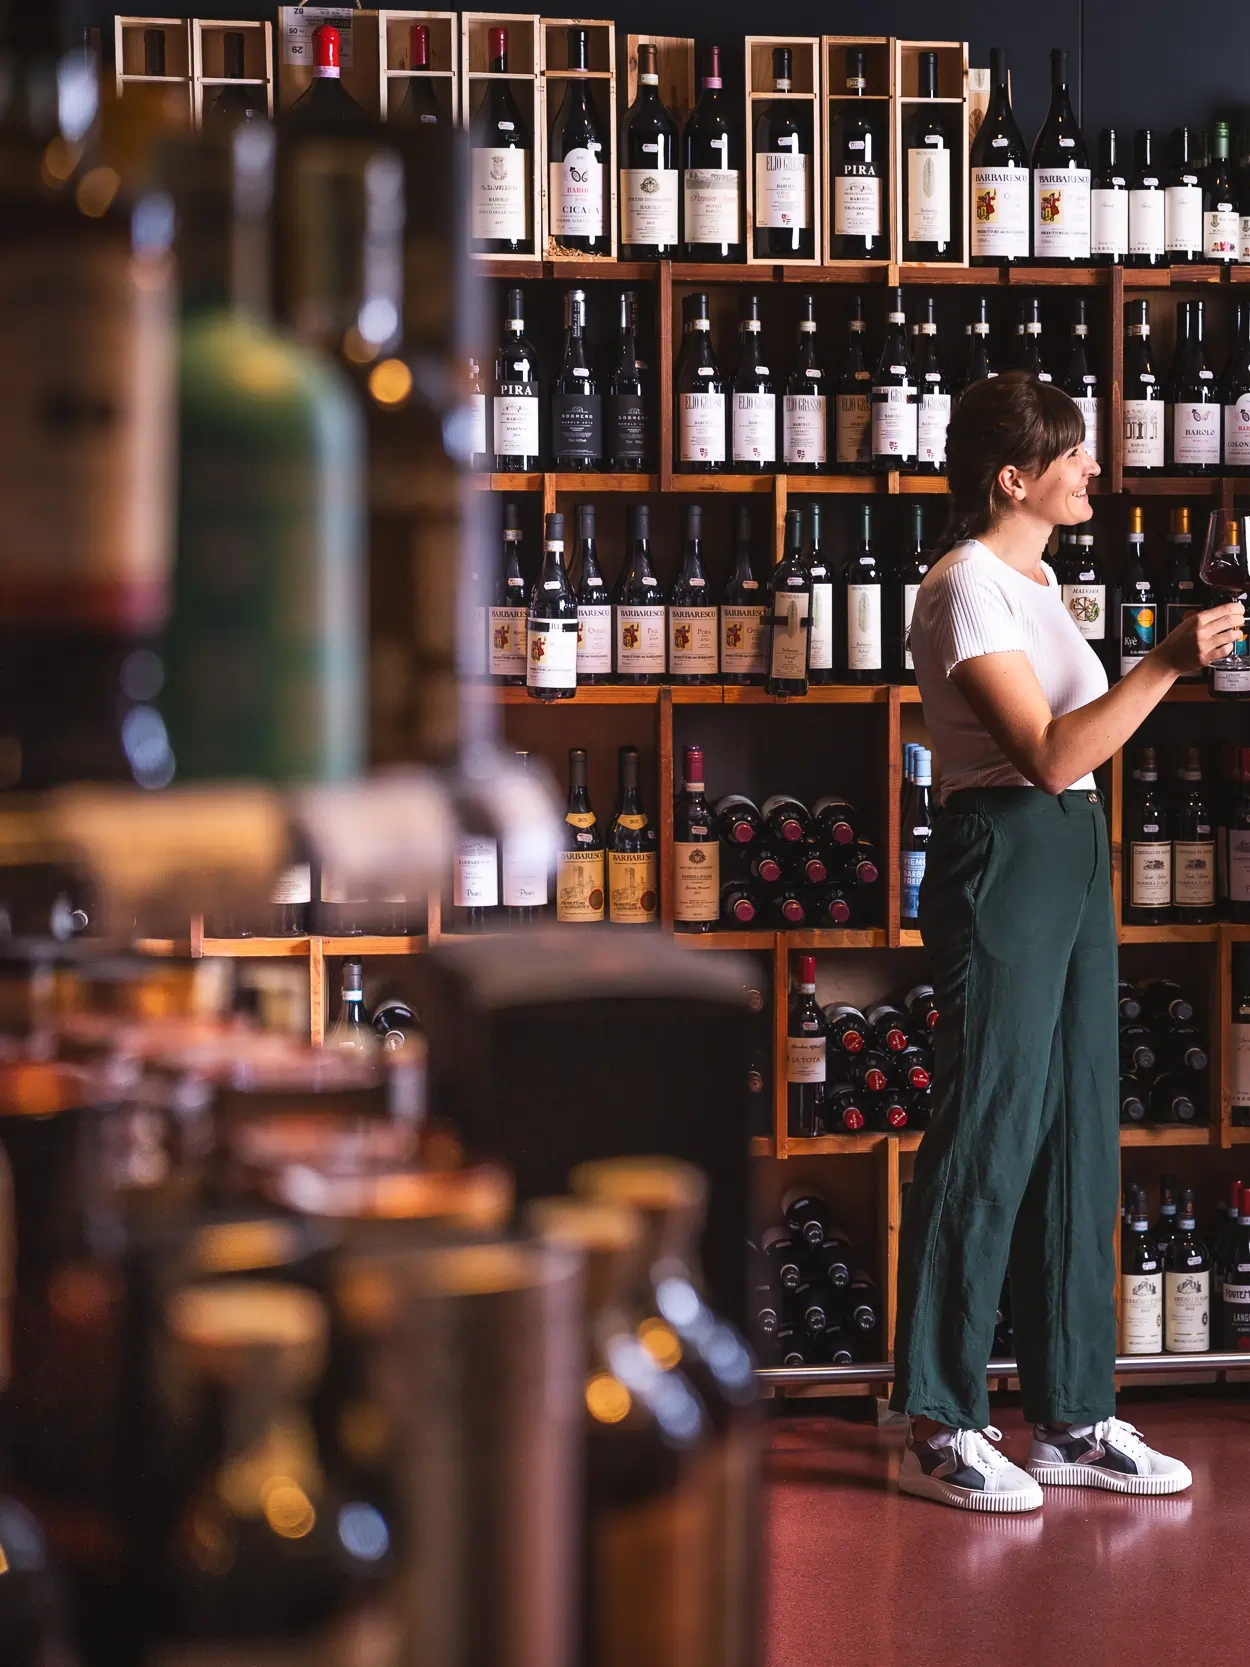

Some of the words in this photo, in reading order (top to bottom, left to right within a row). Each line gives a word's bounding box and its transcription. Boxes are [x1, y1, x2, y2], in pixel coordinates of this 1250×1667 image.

[292, 46, 303, 54] 29
[766, 156, 782, 171] ELIO
[844, 165, 877, 175] PIRA
[976, 174, 1027, 182] BARBARESCO
[1040, 175, 1089, 184] BARBARESCO
[501, 384, 533, 395] PIRA
[685, 396, 698, 410] ELIO
[739, 397, 753, 411] ELIO
[786, 398, 798, 411] ELIO
[799, 399, 821, 411] GRASSO
[856, 400, 872, 411] GRA
[577, 609, 610, 617] BARESCO
[620, 609, 664, 617] BARBARESCO
[672, 610, 716, 619] BARBARESCO
[725, 609, 765, 617] BARBARESC
